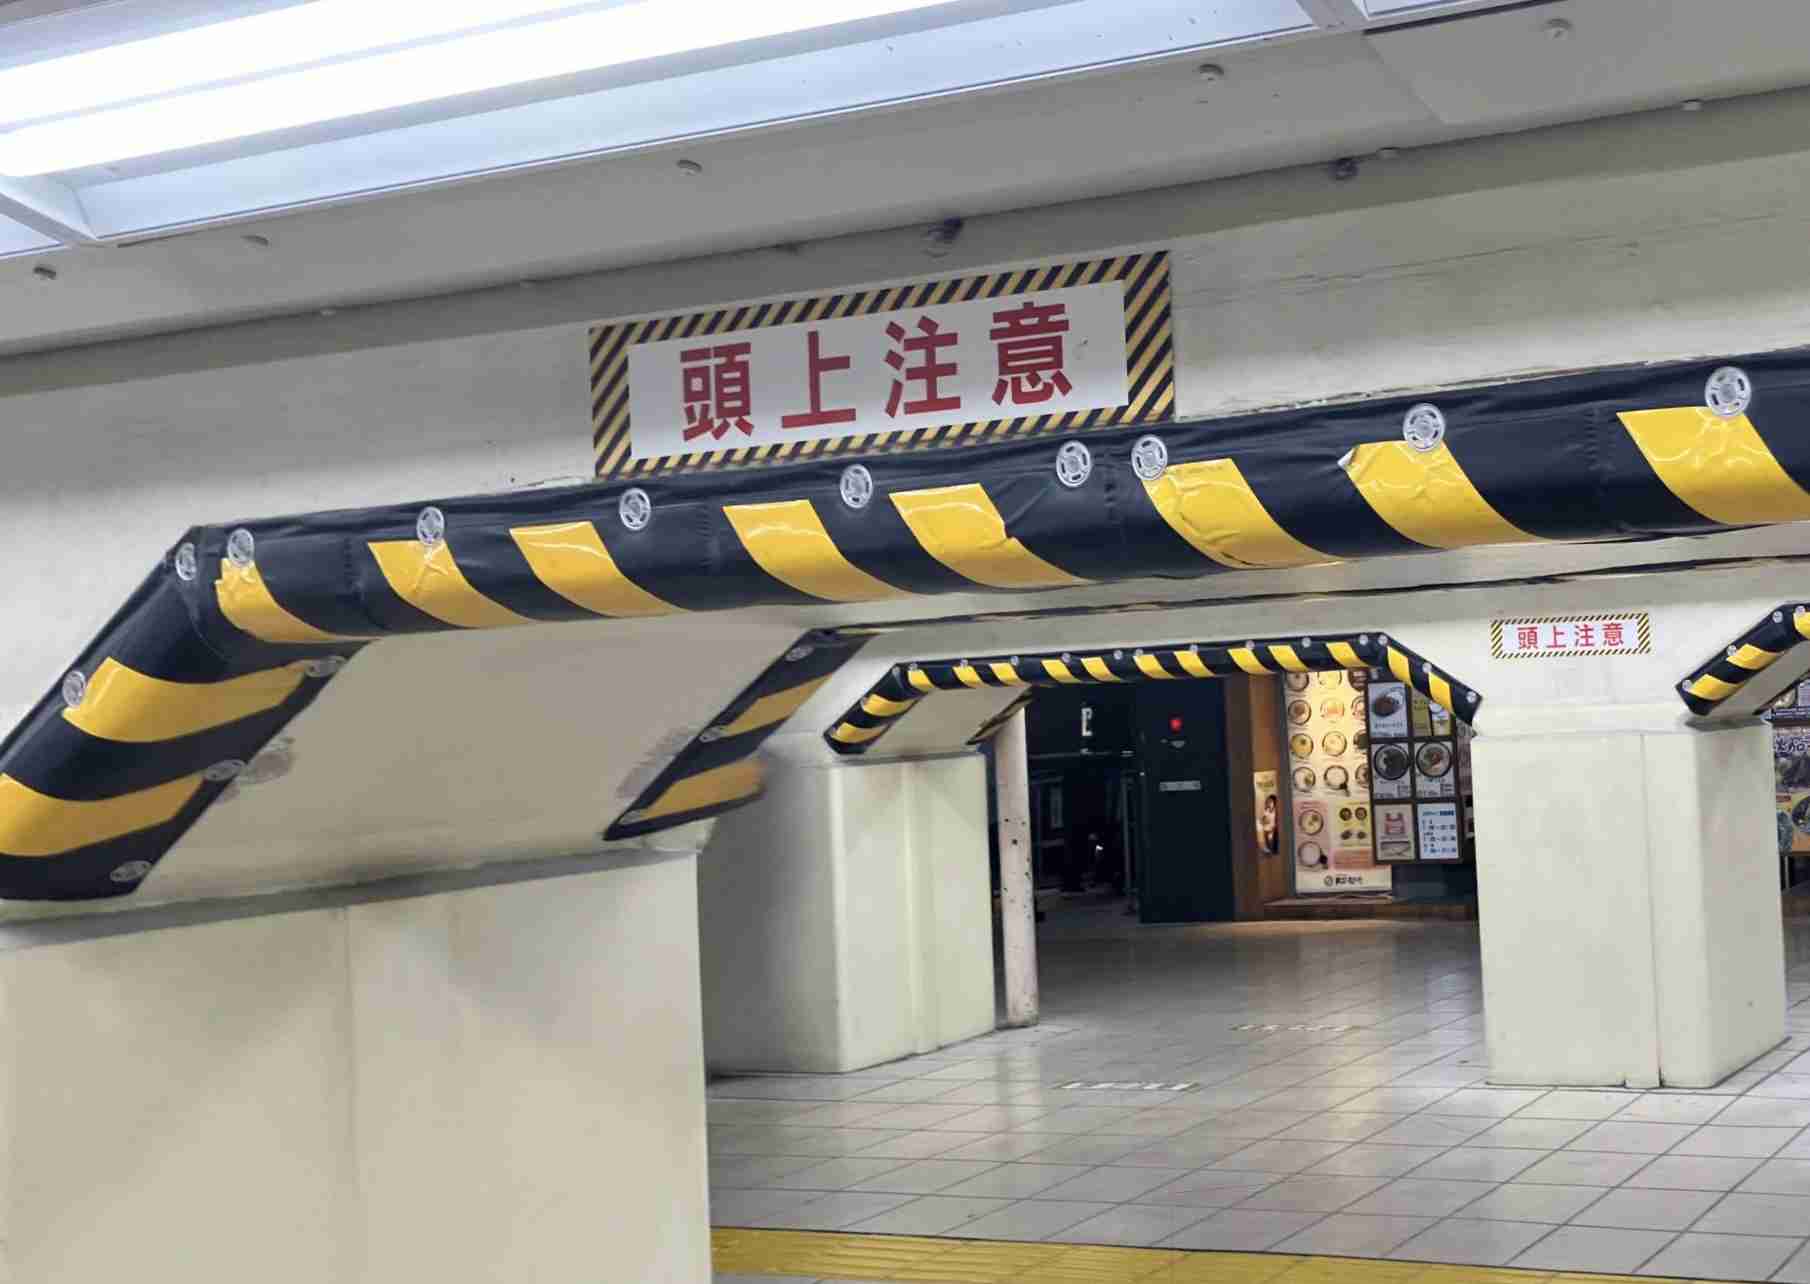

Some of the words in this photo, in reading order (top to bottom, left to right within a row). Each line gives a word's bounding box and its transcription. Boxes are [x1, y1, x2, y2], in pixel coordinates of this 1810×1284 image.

[680, 302, 1073, 442] 頭上注意
[1517, 623, 1624, 650] 頭上注意
